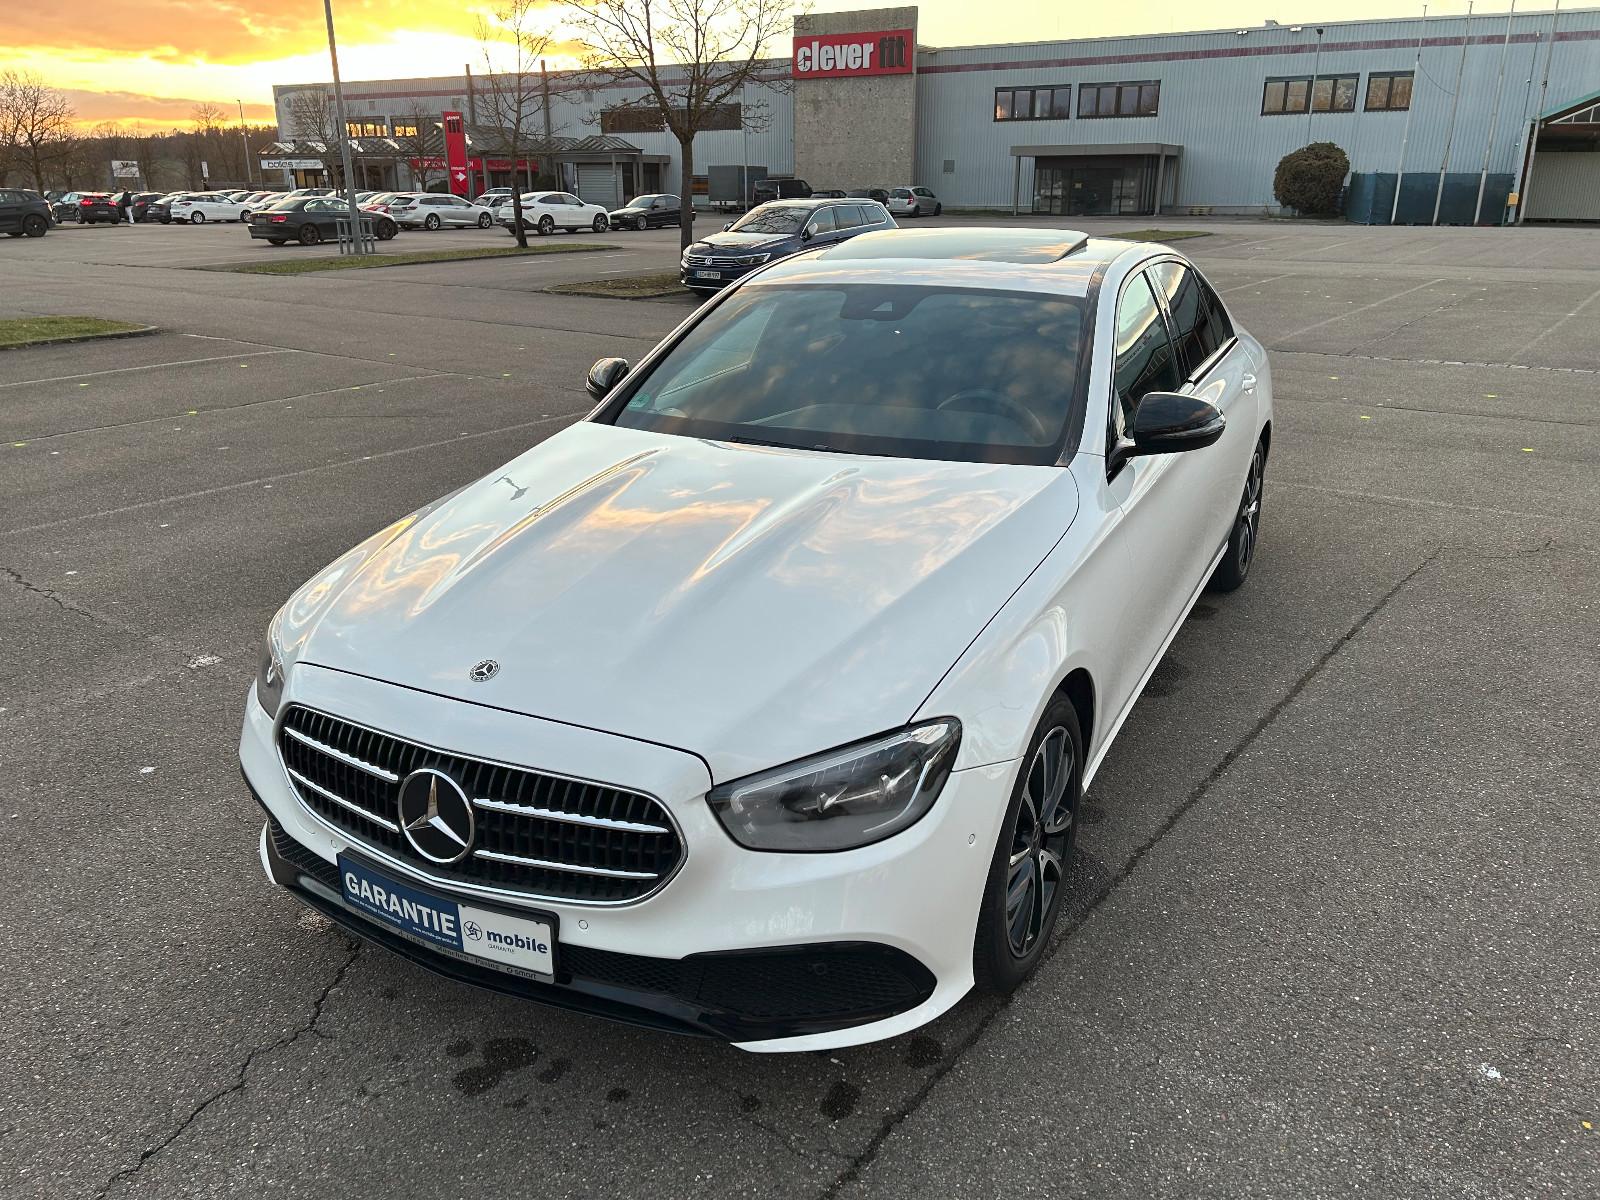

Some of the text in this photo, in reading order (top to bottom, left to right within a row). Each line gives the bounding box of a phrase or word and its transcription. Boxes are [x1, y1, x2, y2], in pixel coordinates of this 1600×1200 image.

[797, 41, 874, 72] clever
[345, 871, 457, 938] GARANTIE
[486, 930, 549, 954] mobile
